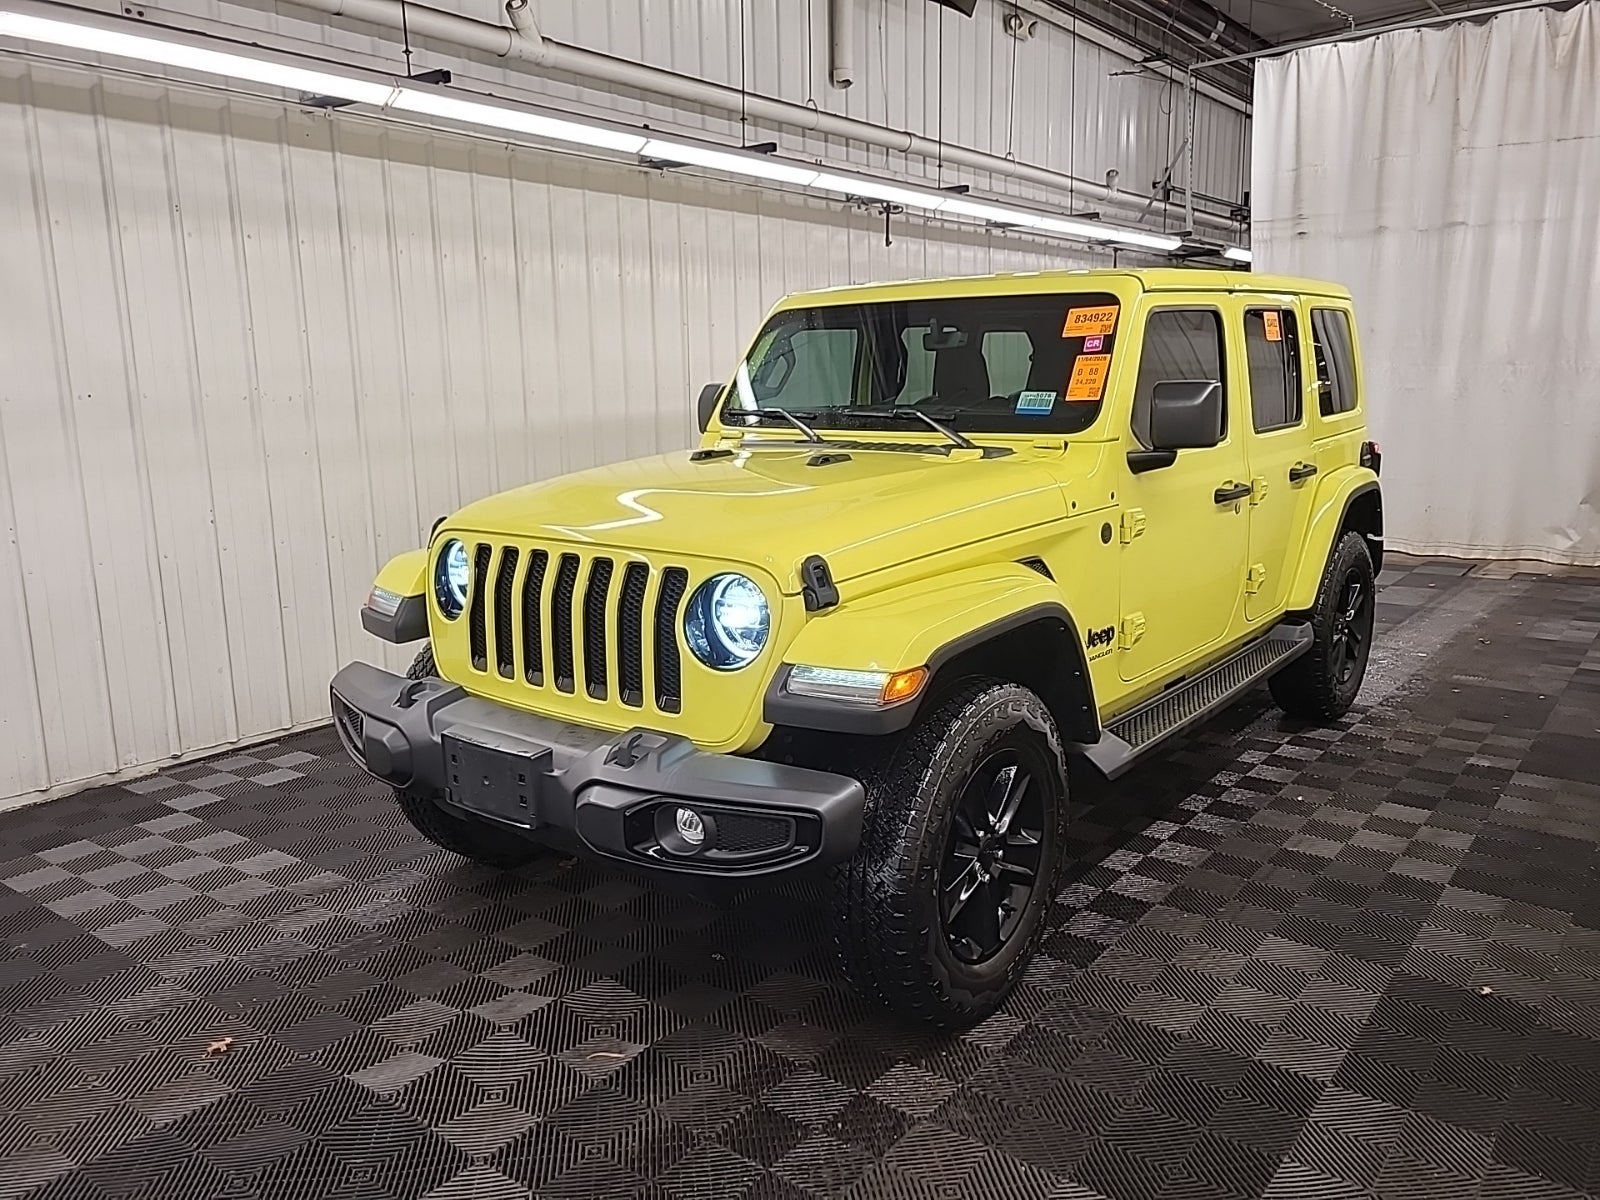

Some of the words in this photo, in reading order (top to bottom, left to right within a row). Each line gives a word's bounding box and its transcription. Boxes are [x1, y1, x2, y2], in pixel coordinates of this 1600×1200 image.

[1074, 311, 1113, 324] 834922
[1086, 339, 1100, 348] CR
[1085, 625, 1115, 650] Jeep
